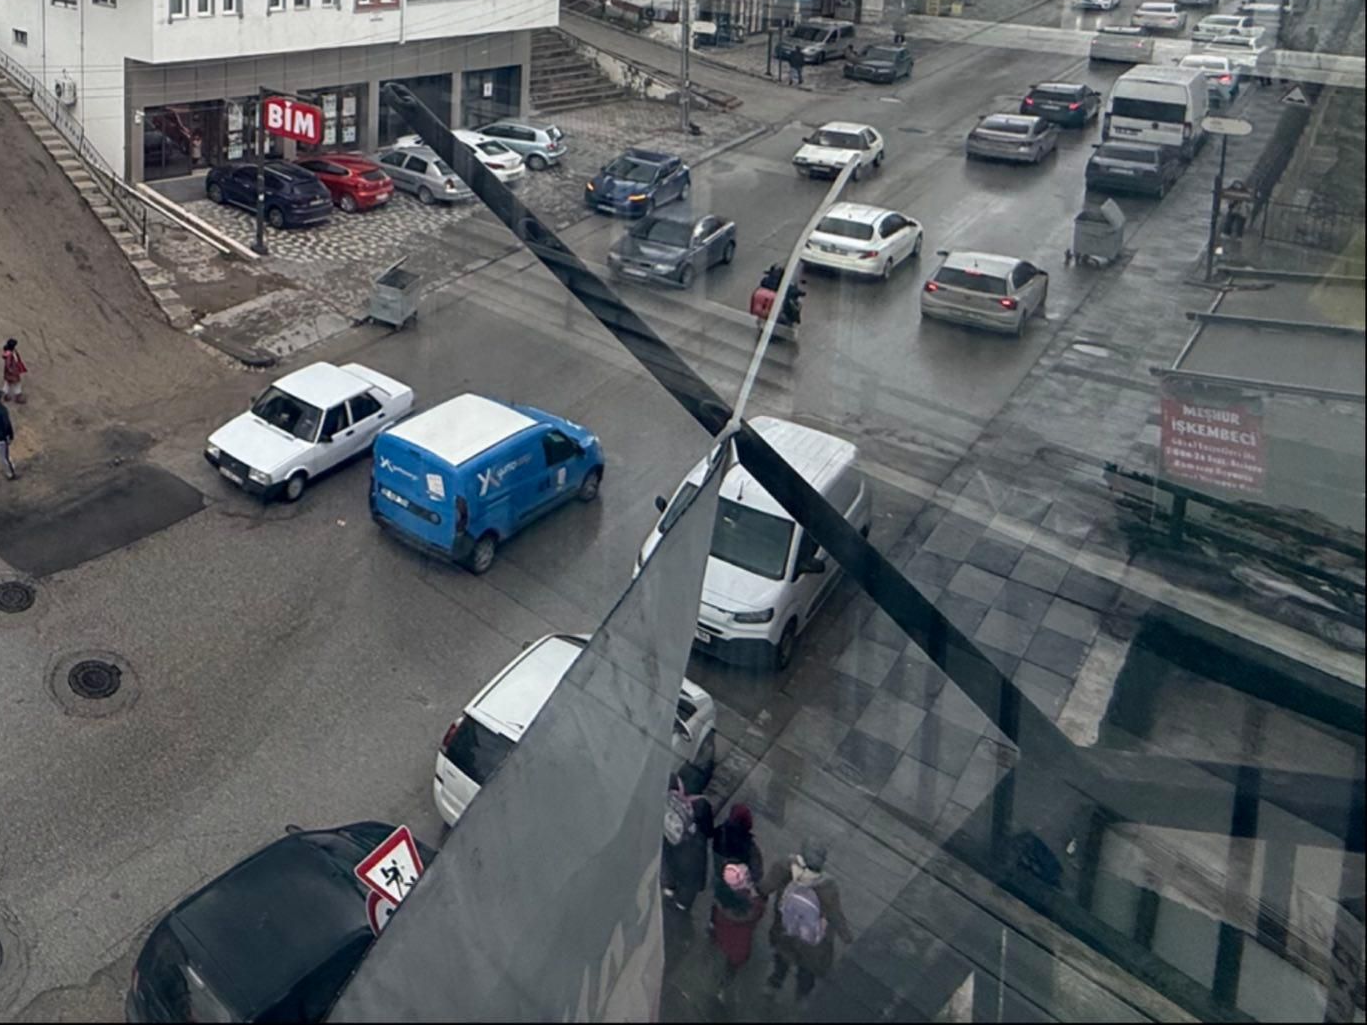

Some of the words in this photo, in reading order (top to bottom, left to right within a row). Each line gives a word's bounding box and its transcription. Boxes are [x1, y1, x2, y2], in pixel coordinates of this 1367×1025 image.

[268, 100, 315, 138] BİM
[1183, 404, 1240, 425] MEŞHUR
[1172, 417, 1256, 446] İŞKEMBECİ
